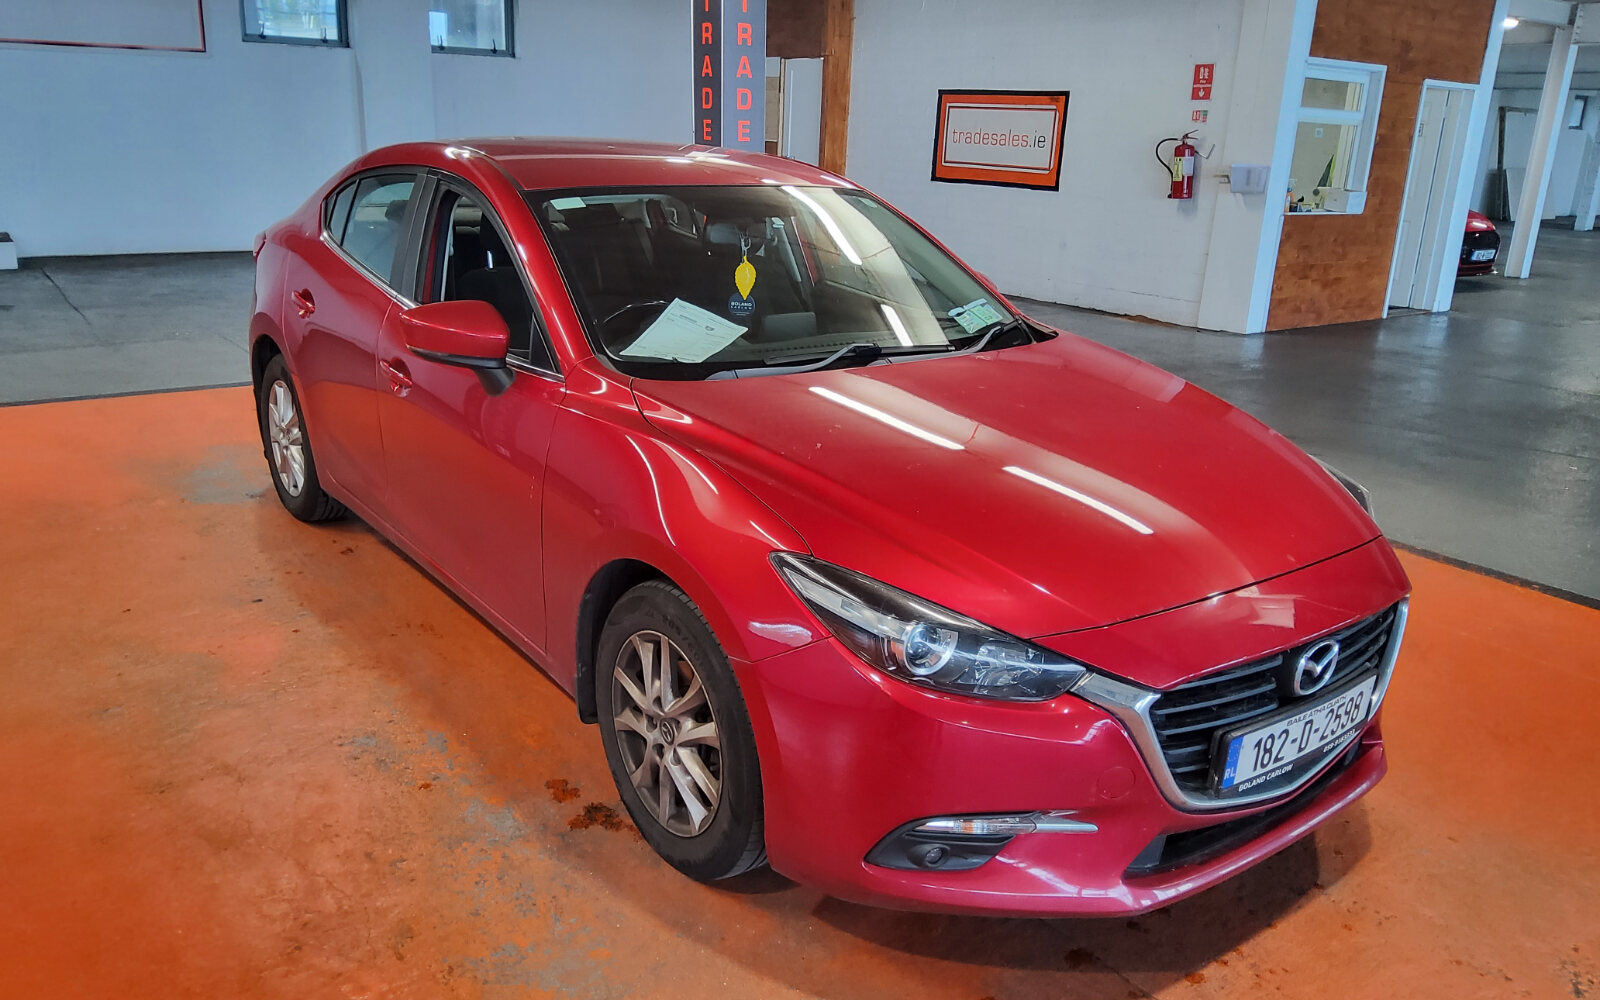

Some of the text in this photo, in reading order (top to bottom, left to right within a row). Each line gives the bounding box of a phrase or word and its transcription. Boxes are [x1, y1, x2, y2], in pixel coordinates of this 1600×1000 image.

[952, 128, 1046, 149] tradesales.ie
[1253, 691, 1364, 772] 182-D-2598
[1238, 763, 1294, 792] BOLAND CARLOW
